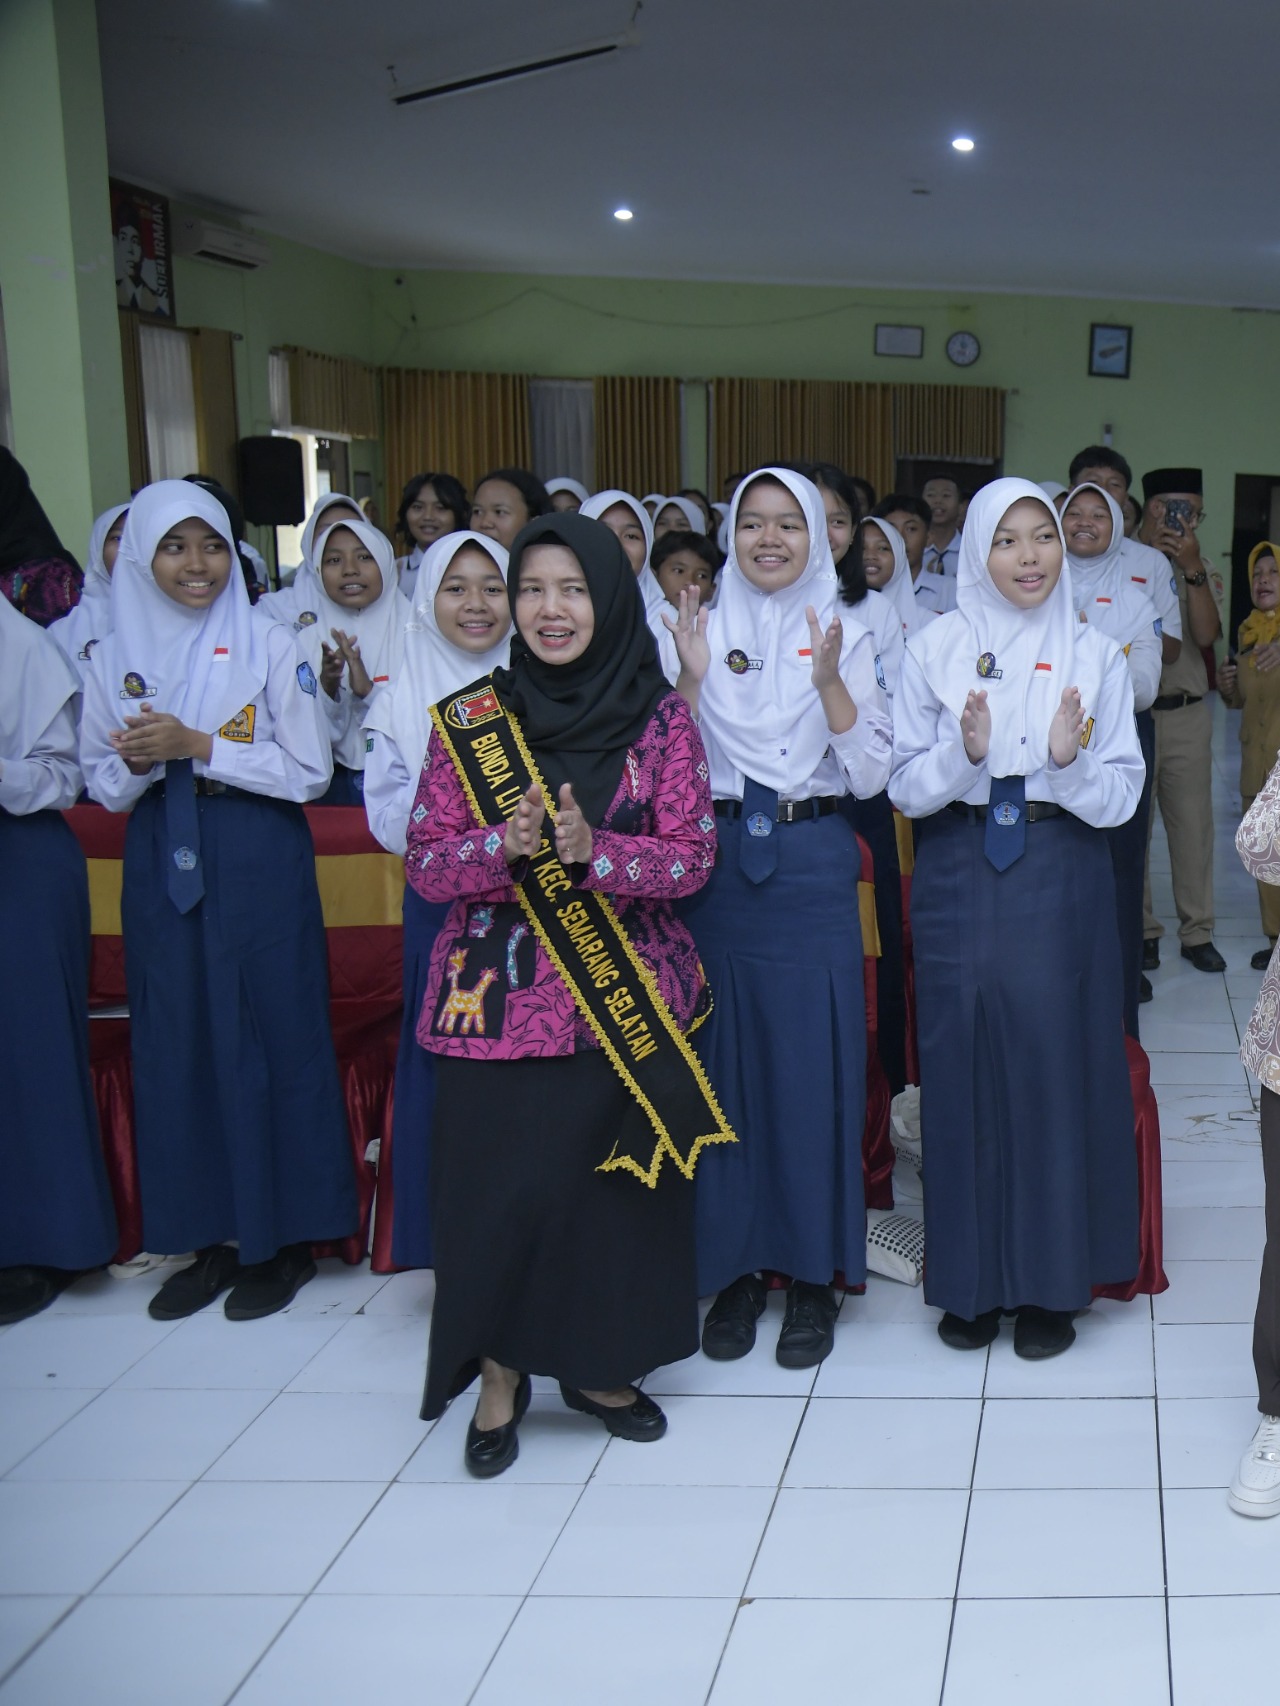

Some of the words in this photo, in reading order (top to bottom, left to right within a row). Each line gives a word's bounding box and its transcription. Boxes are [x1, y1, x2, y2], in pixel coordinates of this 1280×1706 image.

[470, 731, 515, 790] BUNDA
[533, 858, 573, 903] KEC.
[556, 901, 621, 989] SEMARANG
[604, 986, 659, 1064] SELATAN
